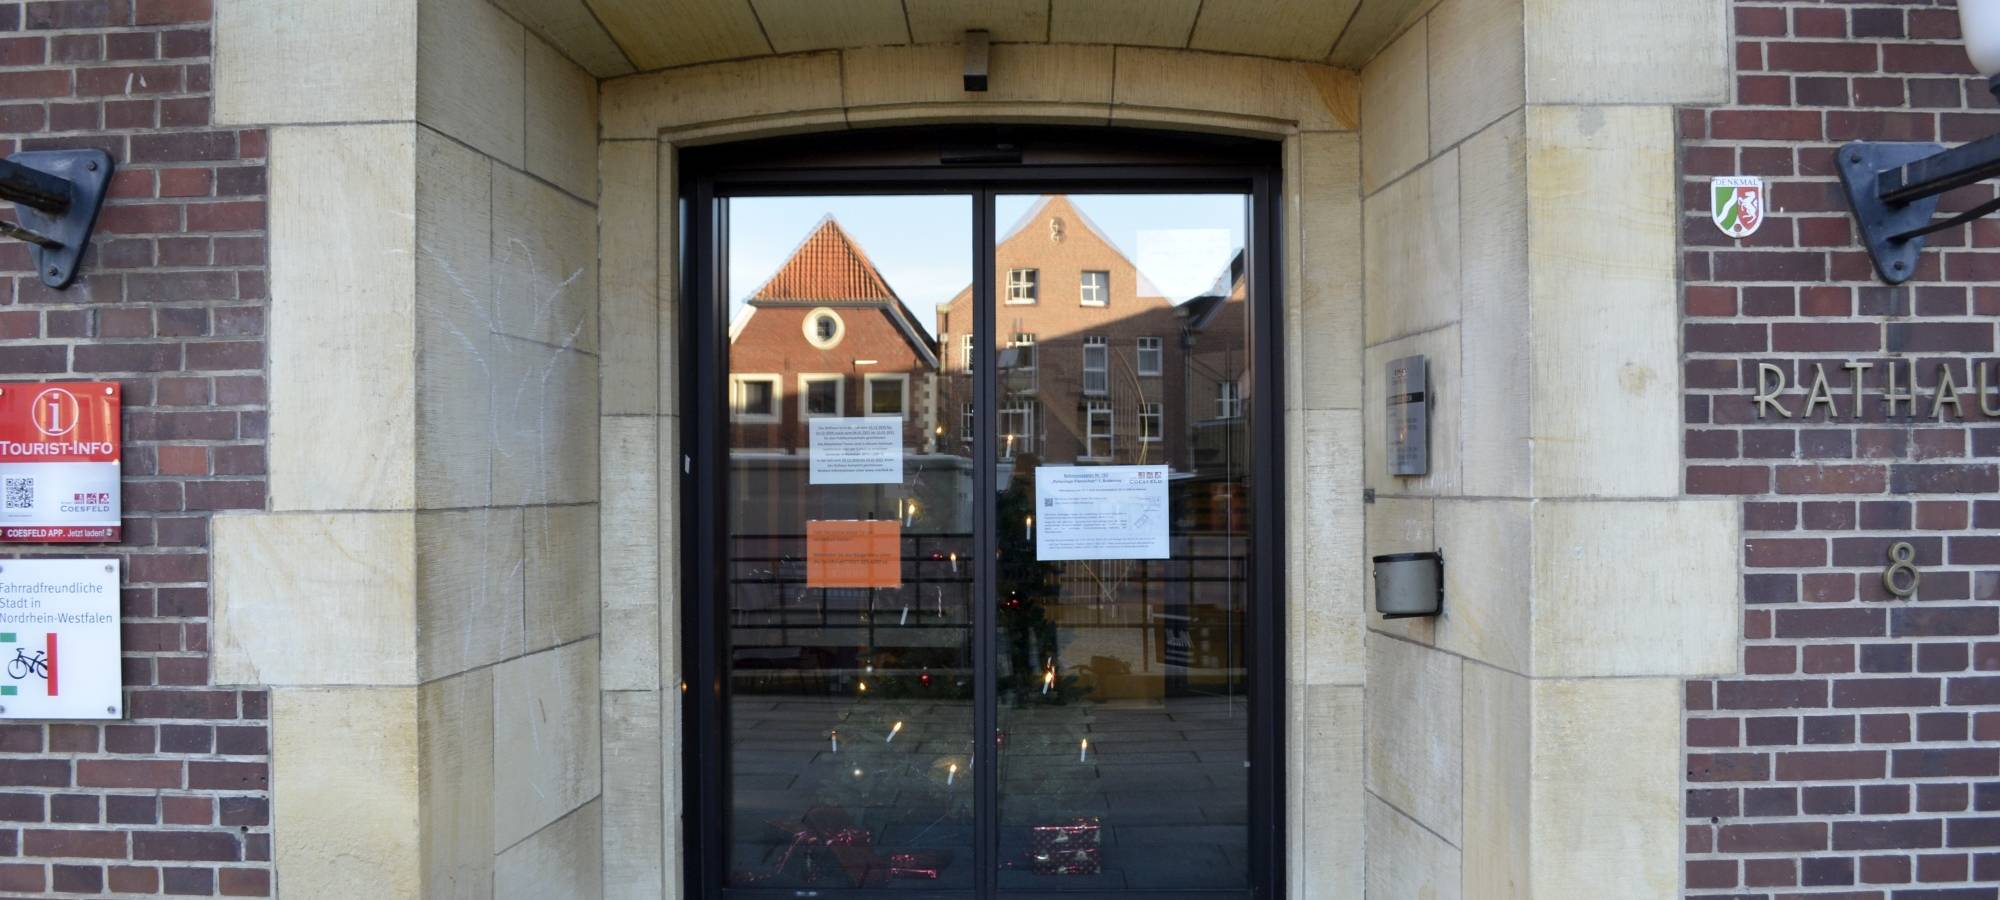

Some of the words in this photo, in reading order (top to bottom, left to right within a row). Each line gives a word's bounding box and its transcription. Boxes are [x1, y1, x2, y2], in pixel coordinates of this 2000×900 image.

[0, 440, 113, 455] TOURIST-INFO
[7, 529, 46, 537] COESFELD
[48, 529, 65, 537] APP.
[67, 529, 83, 537] Jetzt
[84, 528, 105, 537] laden!
[1882, 541, 1920, 597] 8
[0, 582, 103, 594] Fahrradfreundliche
[0, 597, 27, 609] Stadt
[31, 597, 41, 608] in
[0, 612, 113, 624] Nordrhein-Westfalen
